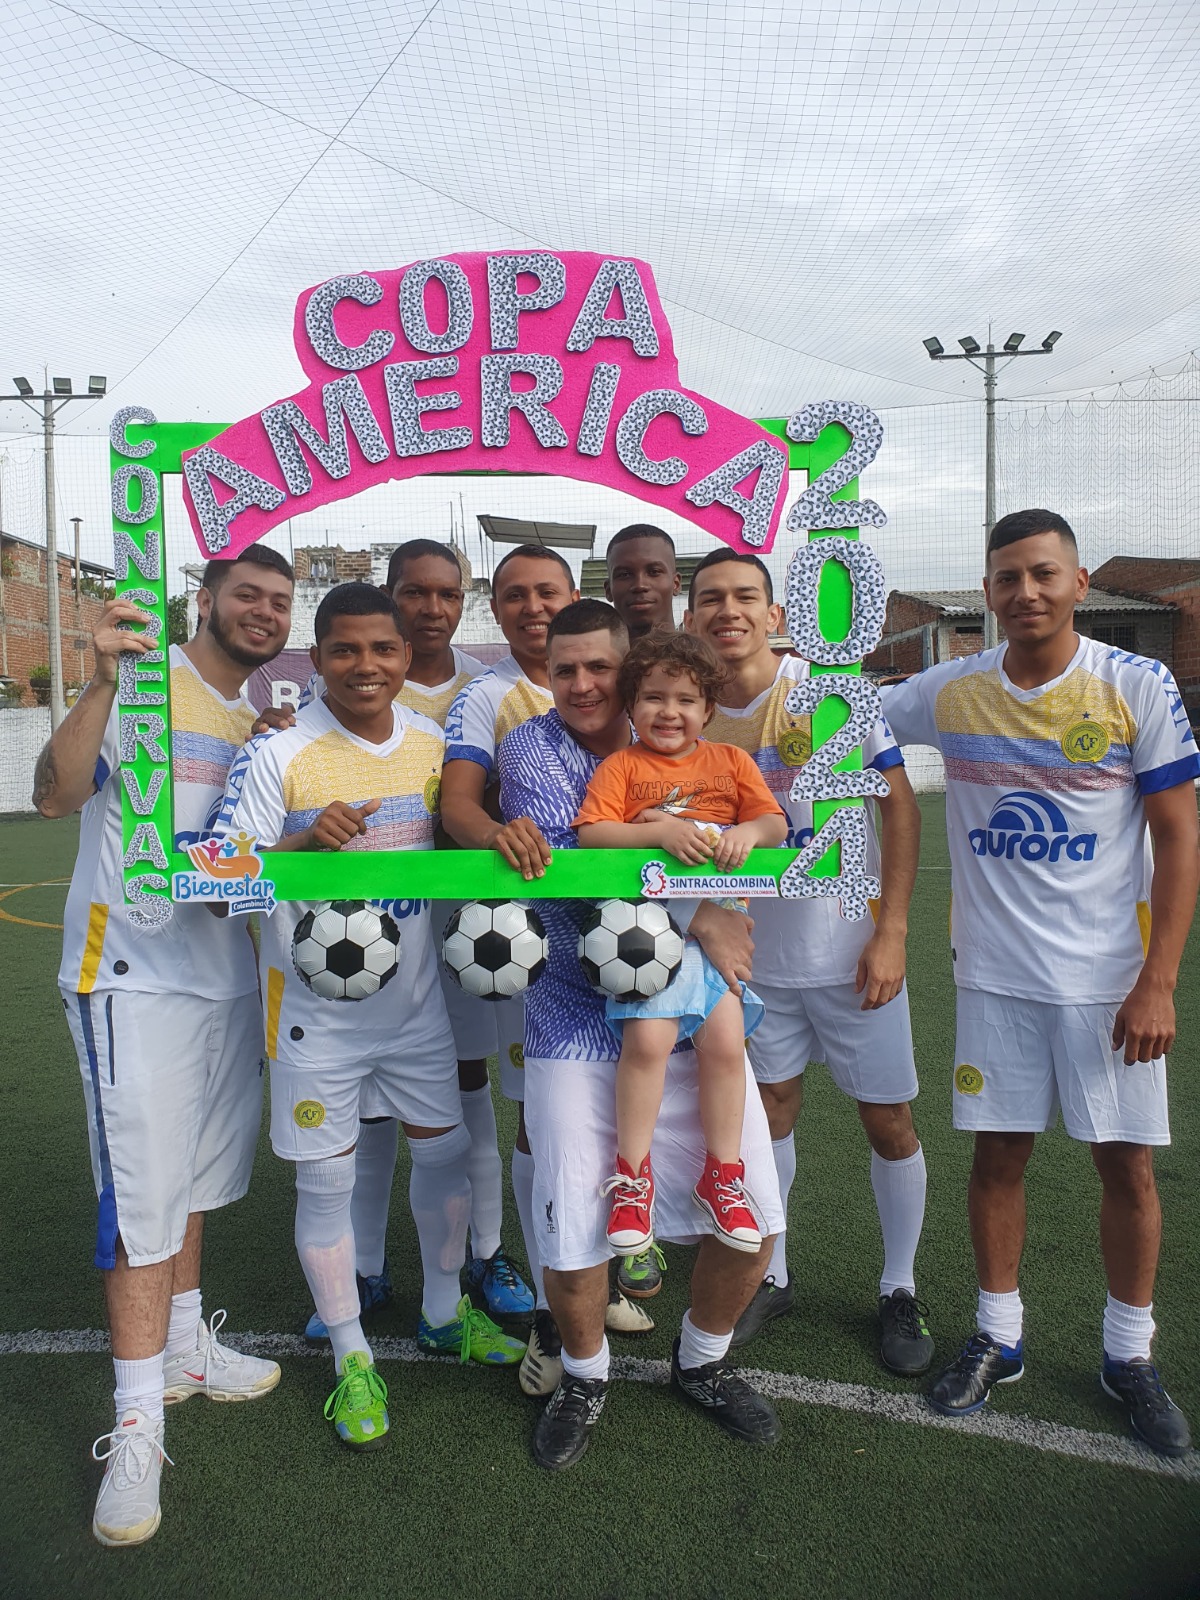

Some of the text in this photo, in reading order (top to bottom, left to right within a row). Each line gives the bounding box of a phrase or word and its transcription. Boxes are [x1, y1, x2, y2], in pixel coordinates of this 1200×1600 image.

[304, 252, 660, 371] COPA
[183, 352, 788, 555] AMERICA
[109, 405, 173, 928] CONSERVAS
[781, 399, 891, 923] 2024
[629, 779, 708, 801] WHAT'S
[968, 827, 1097, 863] aurora
[175, 873, 274, 899] Bienestar
[669, 877, 776, 889] SINTRACOLOMBINA
[233, 899, 264, 912] Colombina
